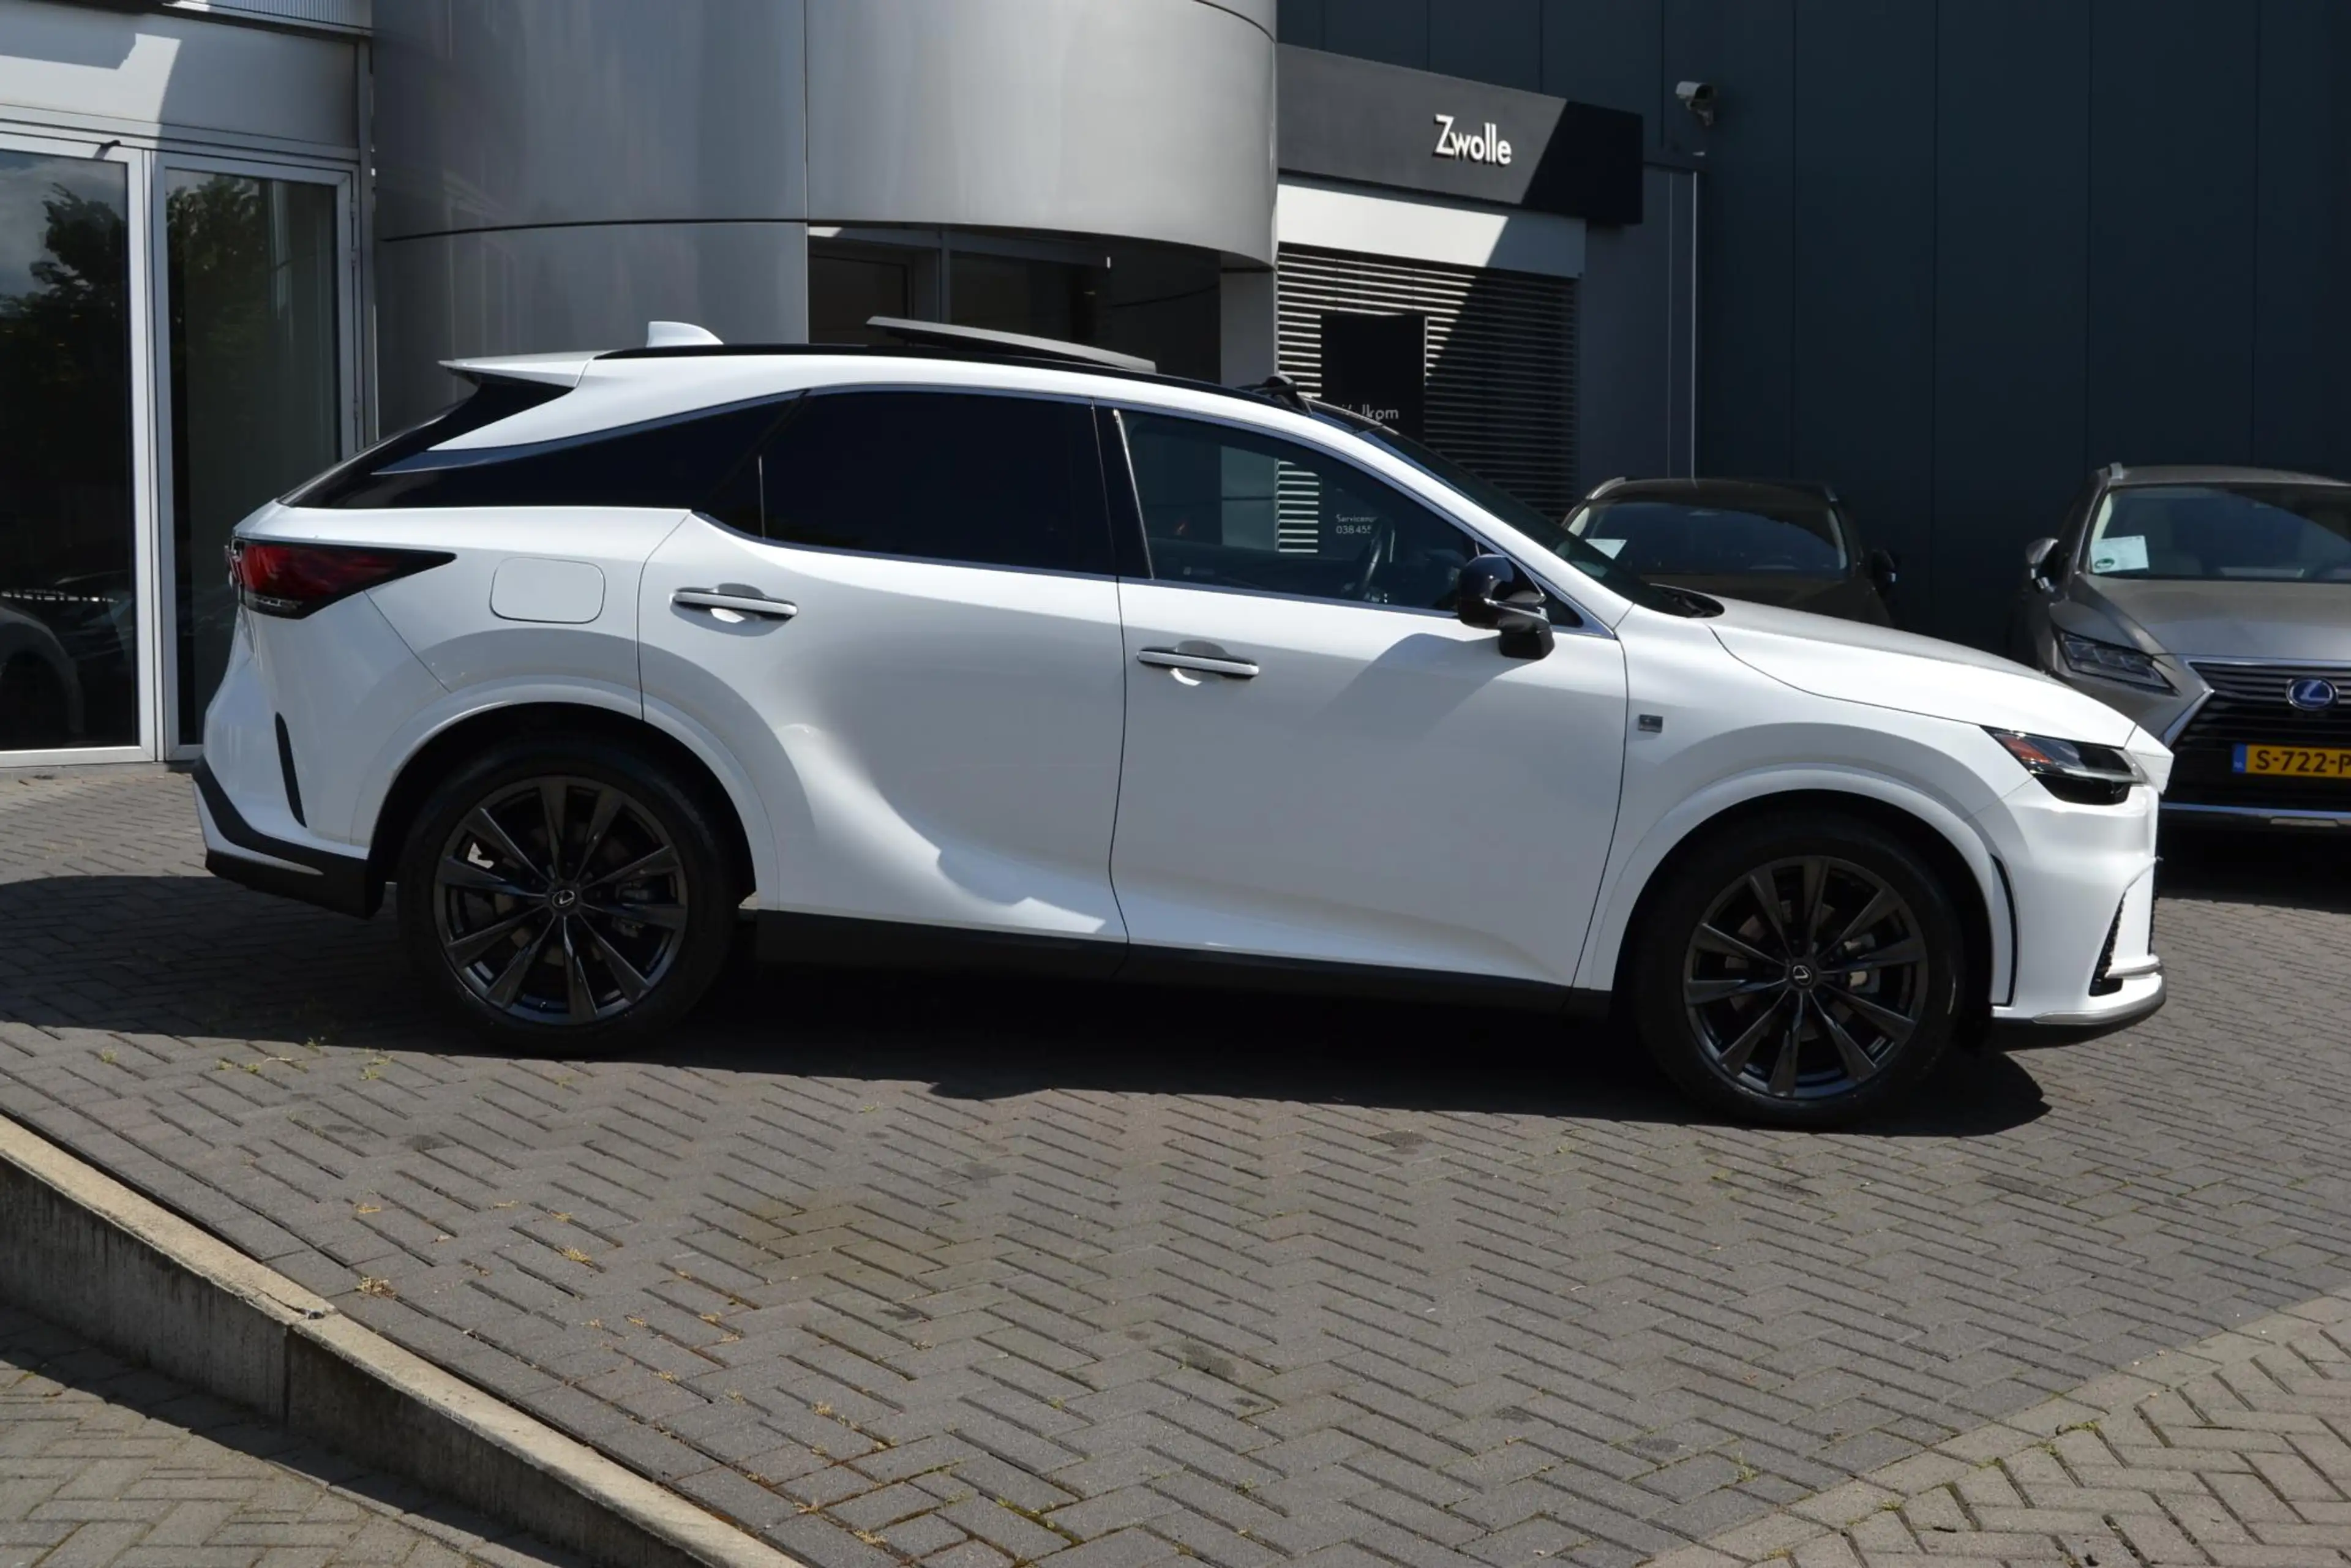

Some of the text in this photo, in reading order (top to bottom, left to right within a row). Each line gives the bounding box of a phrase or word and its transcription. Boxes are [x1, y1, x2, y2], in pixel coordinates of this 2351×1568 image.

[1434, 113, 1512, 165] Zwolle
[1341, 404, 1399, 420] lkom
[1335, 525, 1355, 535] 038
[2255, 749, 2351, 775] S-722-P
